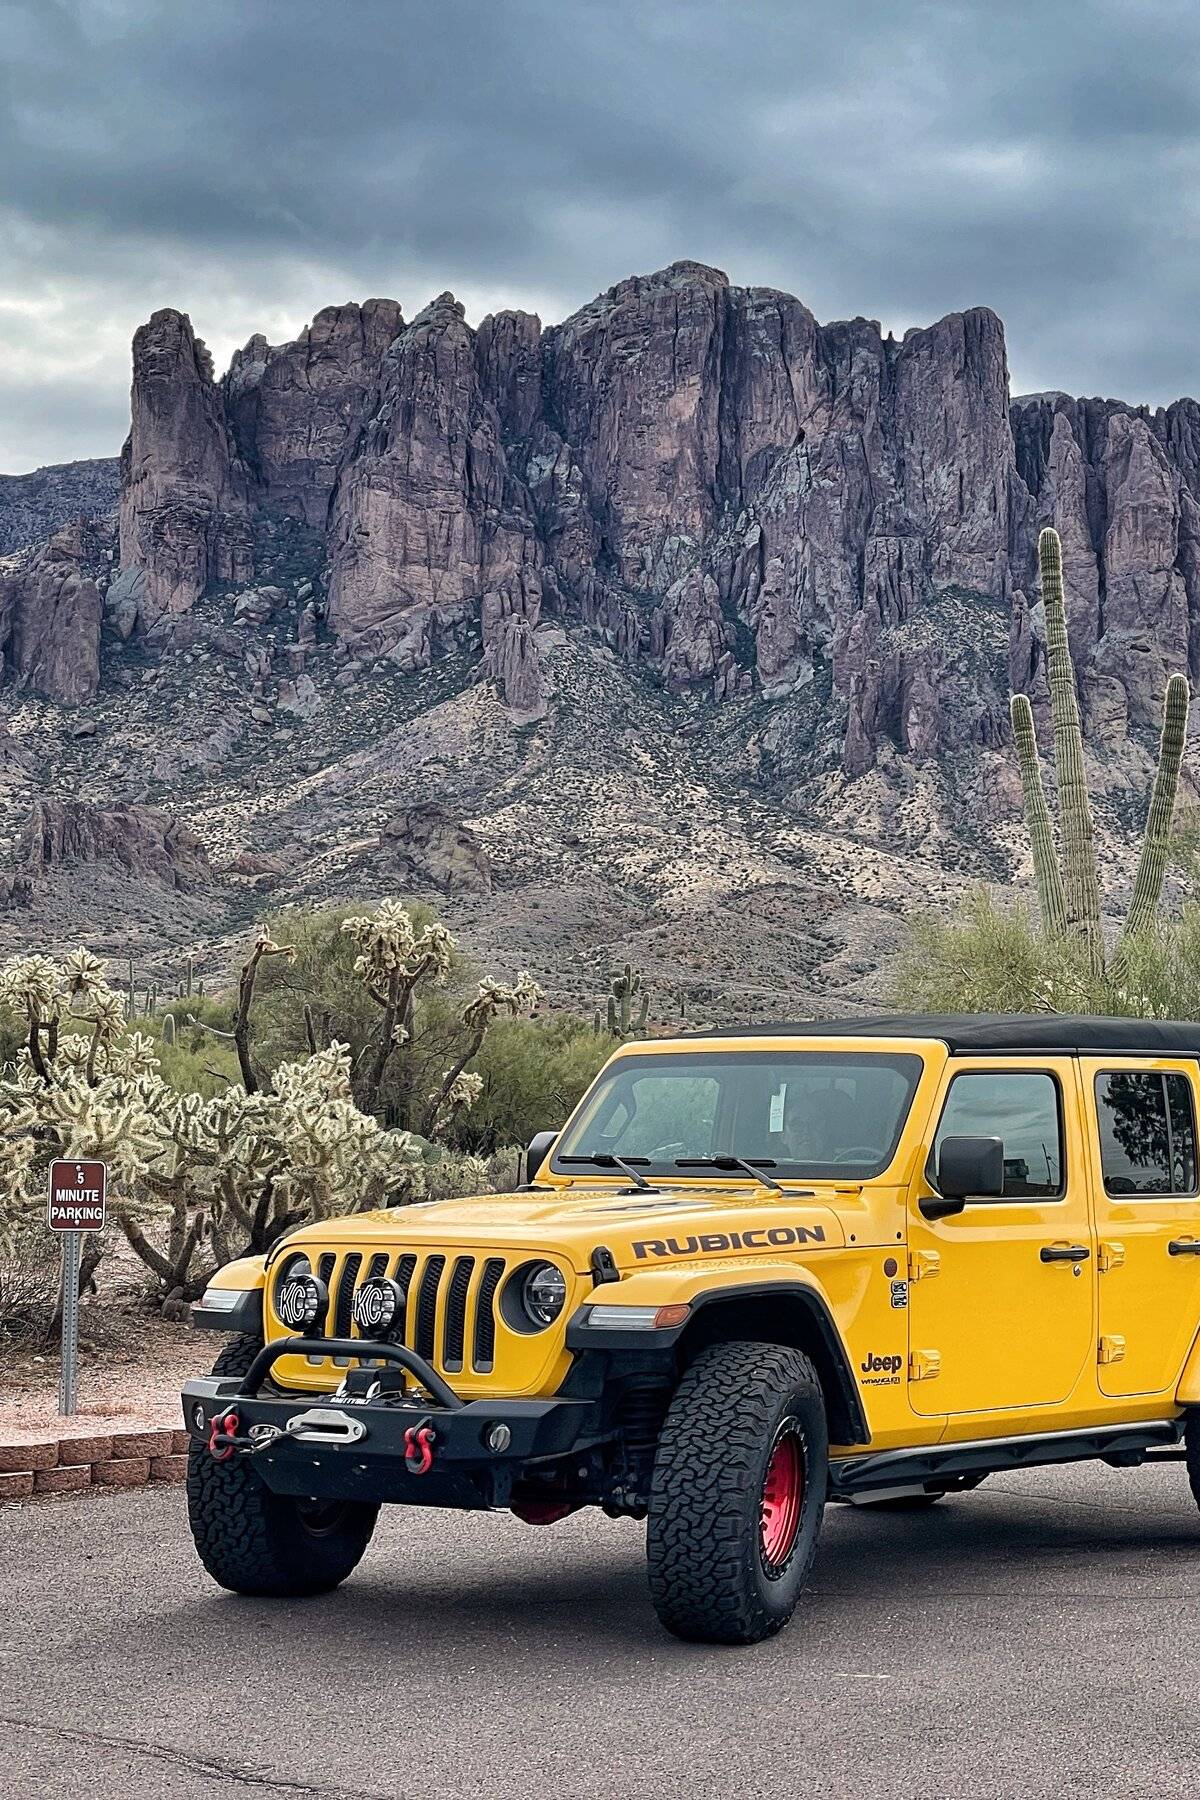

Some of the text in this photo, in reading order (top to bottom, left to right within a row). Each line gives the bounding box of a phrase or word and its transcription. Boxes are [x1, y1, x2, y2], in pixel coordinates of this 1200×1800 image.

[77, 1172, 85, 1184] 5
[56, 1189, 99, 1202] MINUTE
[51, 1207, 103, 1220] PARKING
[631, 1225, 826, 1259] RUBICON
[280, 1282, 306, 1324] KC
[354, 1284, 383, 1327] KC
[861, 1352, 902, 1374] Jeep
